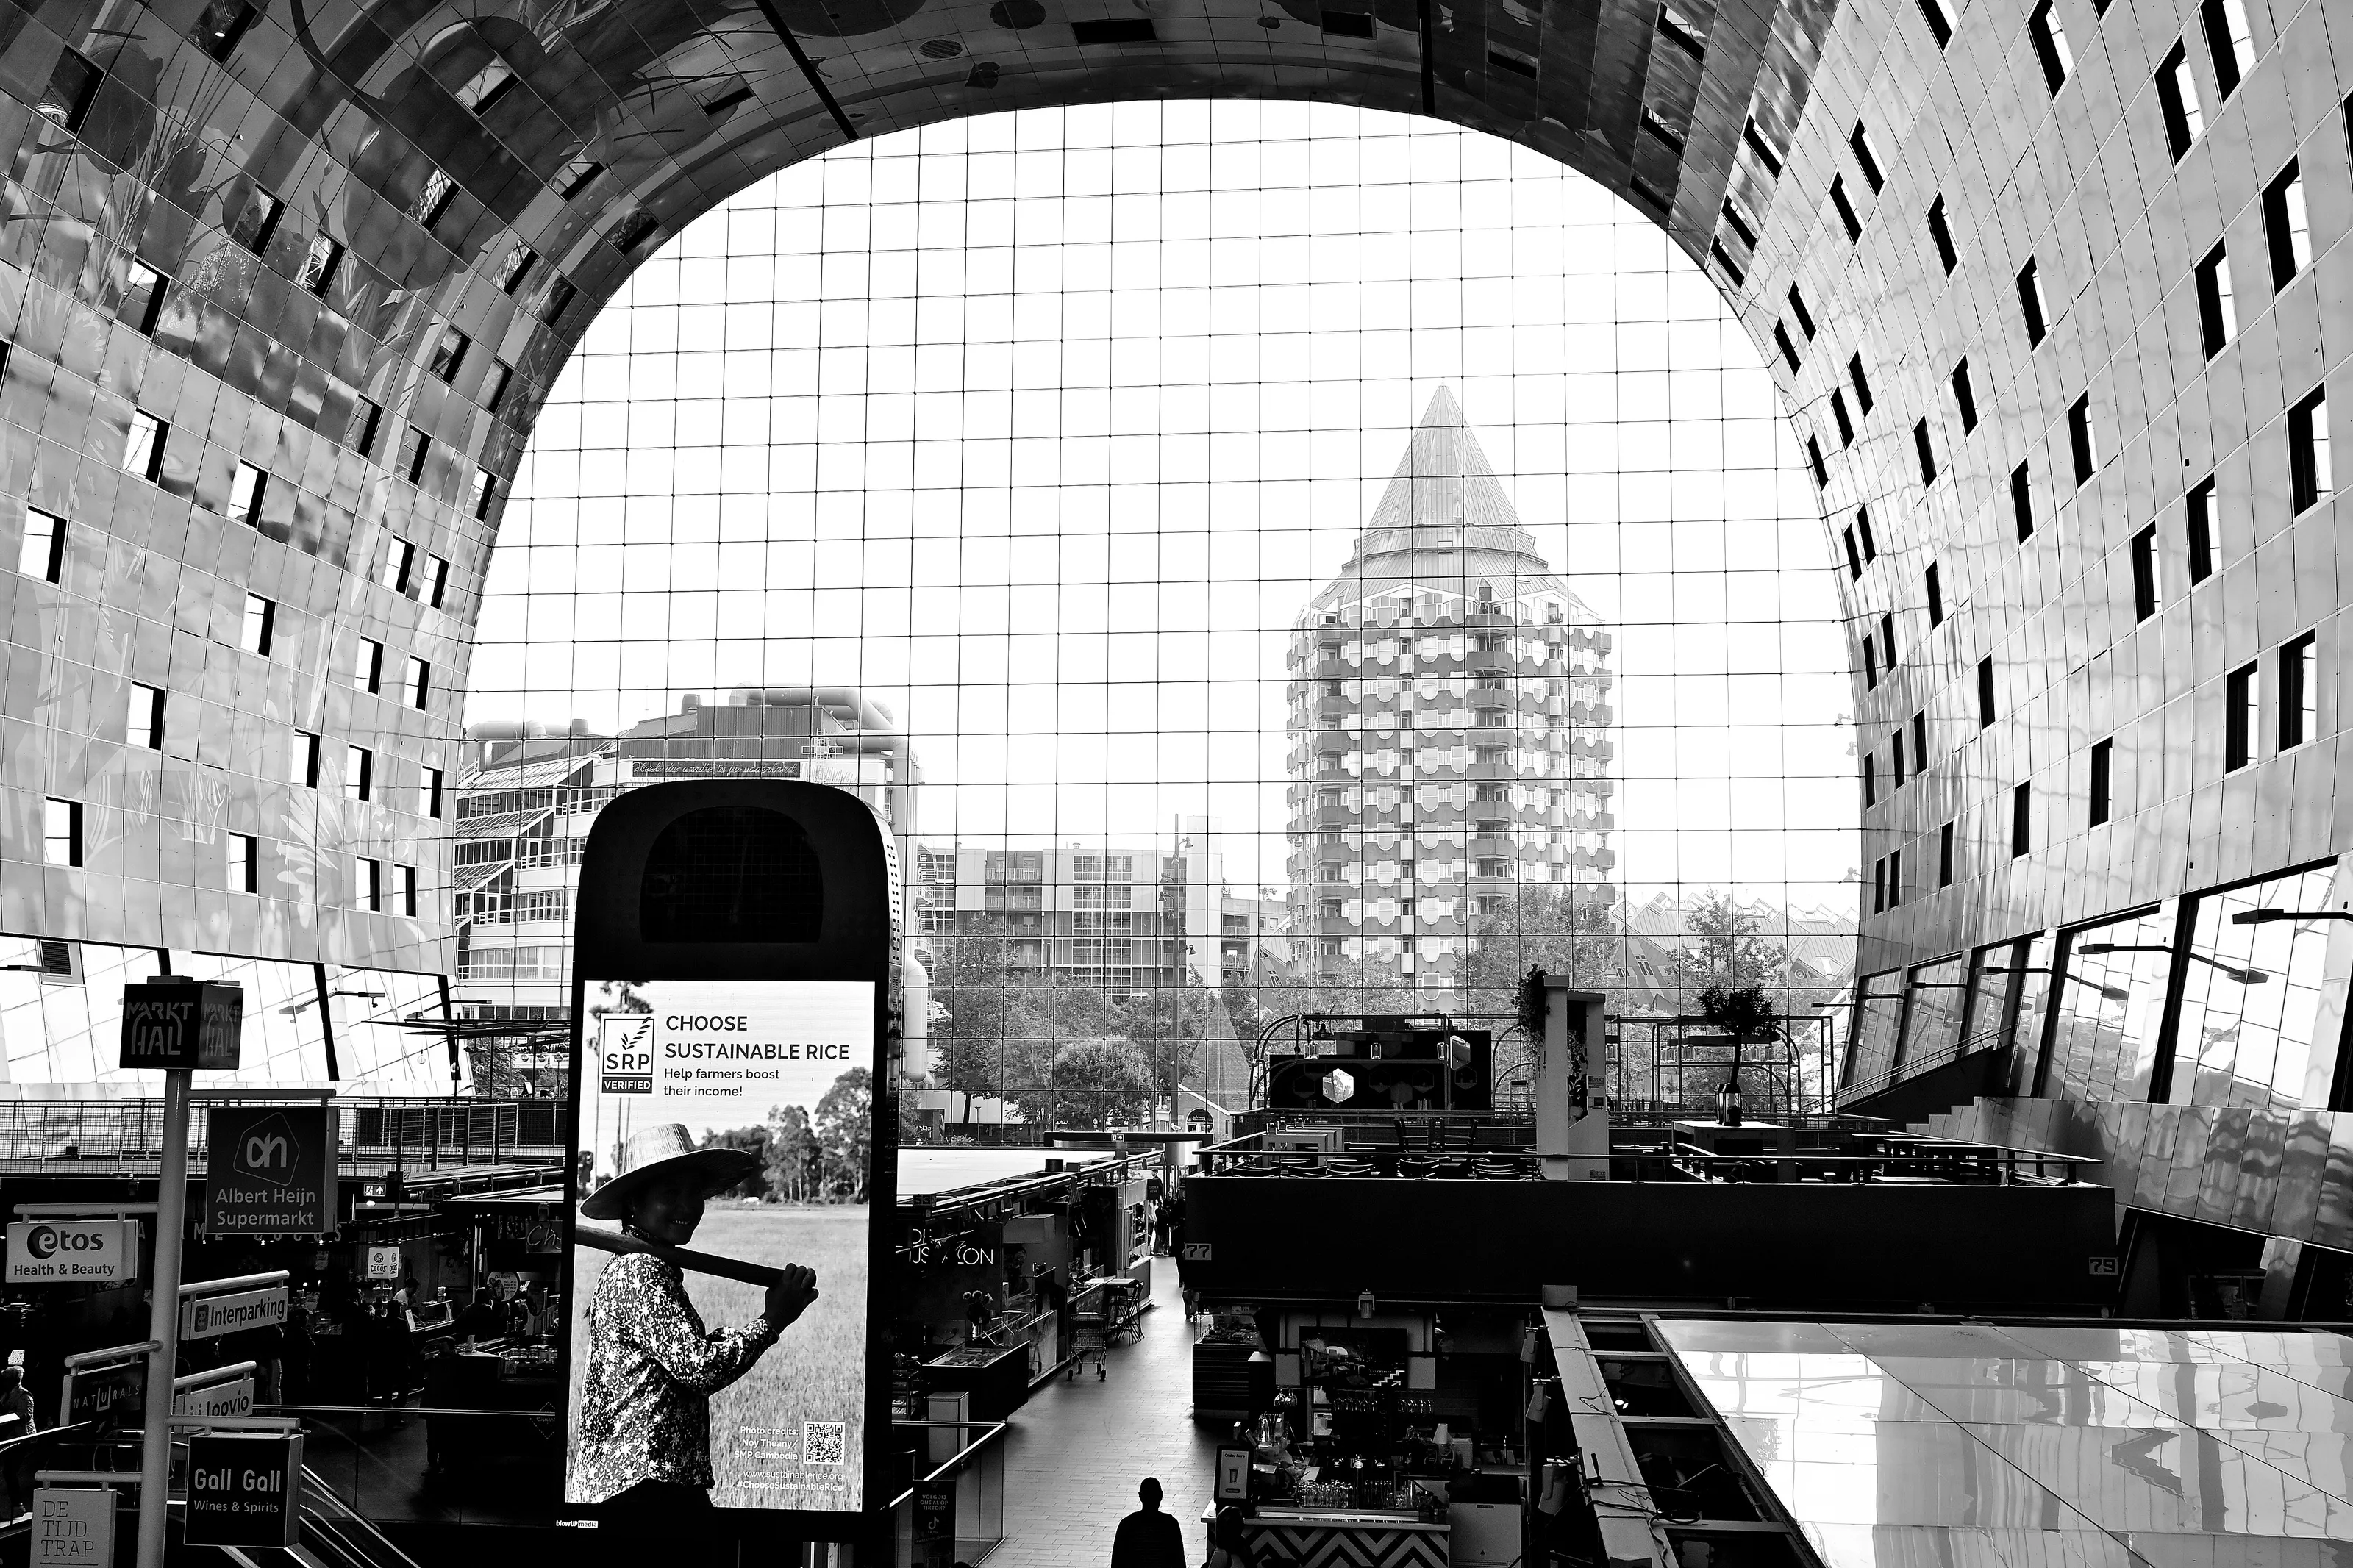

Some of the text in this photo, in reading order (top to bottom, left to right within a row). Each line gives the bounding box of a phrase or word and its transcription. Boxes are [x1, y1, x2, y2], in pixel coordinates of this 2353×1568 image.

[126, 1002, 194, 1020] MARKT
[204, 1003, 240, 1022] MARKT
[666, 1015, 748, 1031] CHOOSE
[131, 1013, 182, 1056] HAL
[205, 1014, 234, 1057] HAL
[665, 1043, 850, 1060] SUSTAINABLE RICE
[606, 1053, 651, 1070] SRP
[664, 1067, 780, 1081] Help farmers boost
[603, 1079, 651, 1091] VERIFIED
[663, 1085, 743, 1097] their income!
[216, 1186, 316, 1208] Albert Heijn
[217, 1210, 315, 1228] Supermarkt
[40, 1227, 104, 1253] etos
[1186, 1244, 1210, 1259] 77
[13, 1261, 115, 1278] Health & Beauty
[2090, 1259, 2115, 1273] 79
[210, 1297, 285, 1327] Interparking
[73, 1384, 140, 1412] NATURALS
[740, 1425, 799, 1436] Photo credits:
[742, 1438, 799, 1450] Noy Theany/
[734, 1450, 799, 1460] SMP Cambodia
[194, 1468, 281, 1492] Gall Gall
[743, 1470, 844, 1482] www.sustainablerice.org
[736, 1480, 844, 1492] #ChooseSustainableRice
[42, 1500, 68, 1518] DE
[193, 1500, 279, 1514] Wines & Spirits
[41, 1519, 88, 1537] TIJD
[40, 1539, 94, 1558] TRAP
